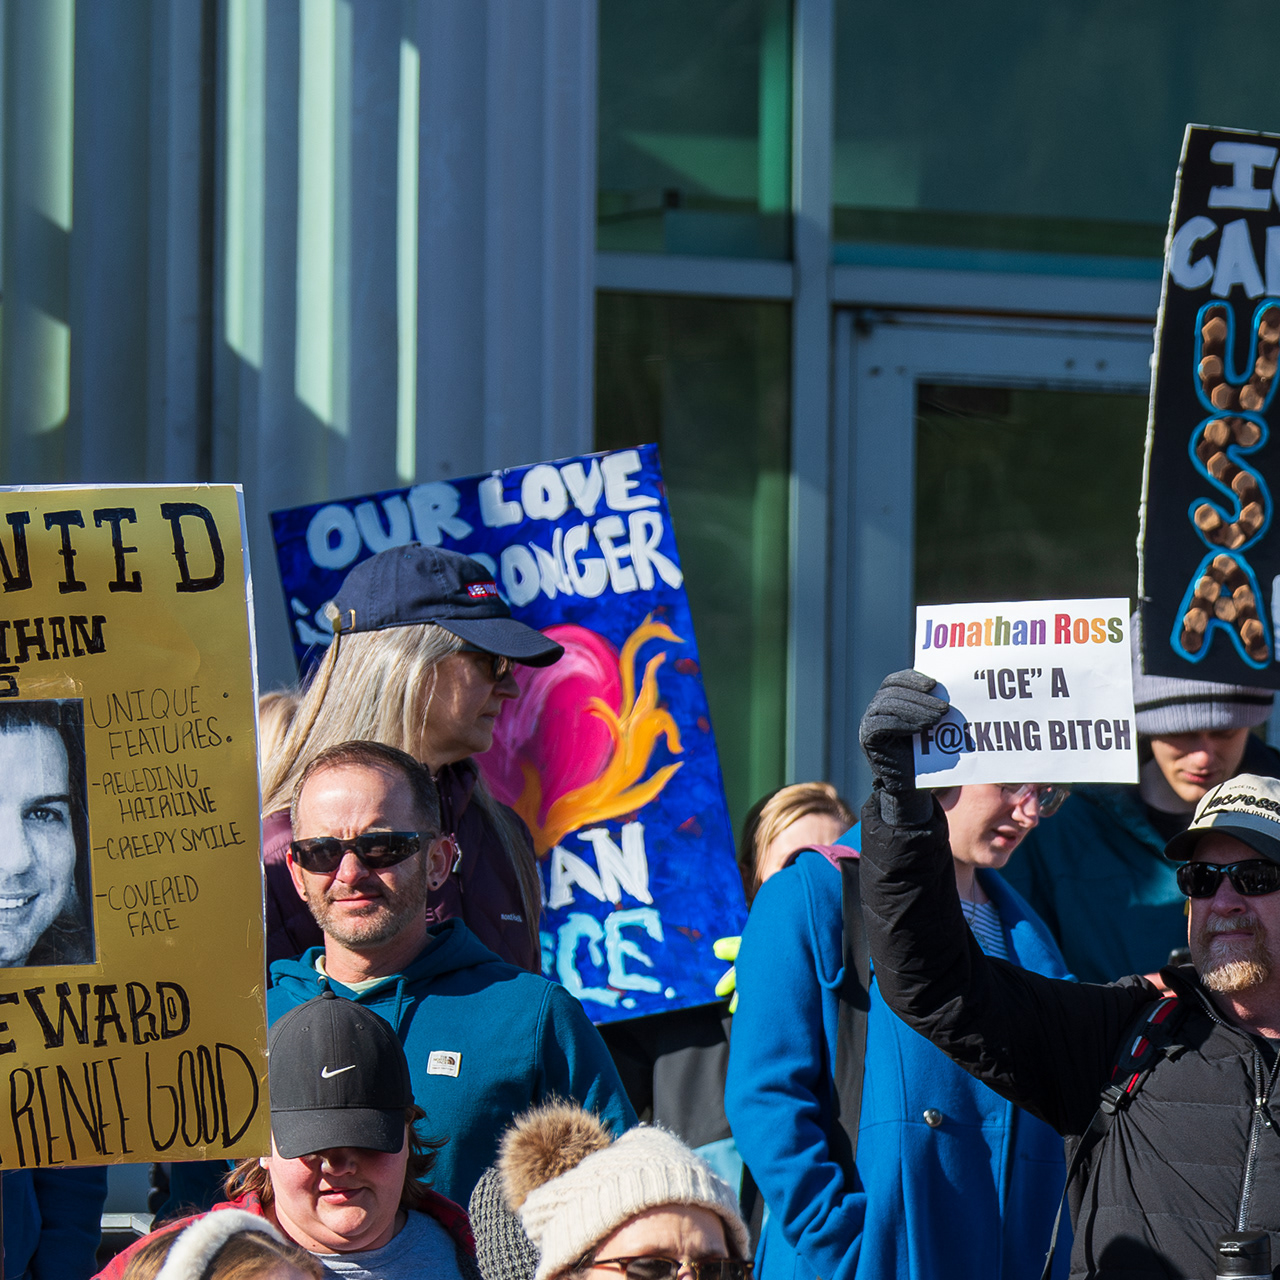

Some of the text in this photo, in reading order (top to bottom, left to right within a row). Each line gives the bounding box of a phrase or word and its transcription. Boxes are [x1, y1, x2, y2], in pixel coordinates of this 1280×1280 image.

[306, 450, 660, 570] OUR LOVE
[467, 510, 684, 608] ONGER
[922, 614, 1124, 650] Jonathan Ross
[1051, 667, 1070, 698] A
[90, 686, 201, 729] UNIQUE
[1050, 719, 1132, 751] BITCH
[118, 787, 217, 824] HAIRLINE
[182, 822, 246, 852] SMILE
[536, 821, 654, 911] AN
[127, 908, 180, 937] FACE
[9, 1043, 259, 1167] RENEE GOOD
